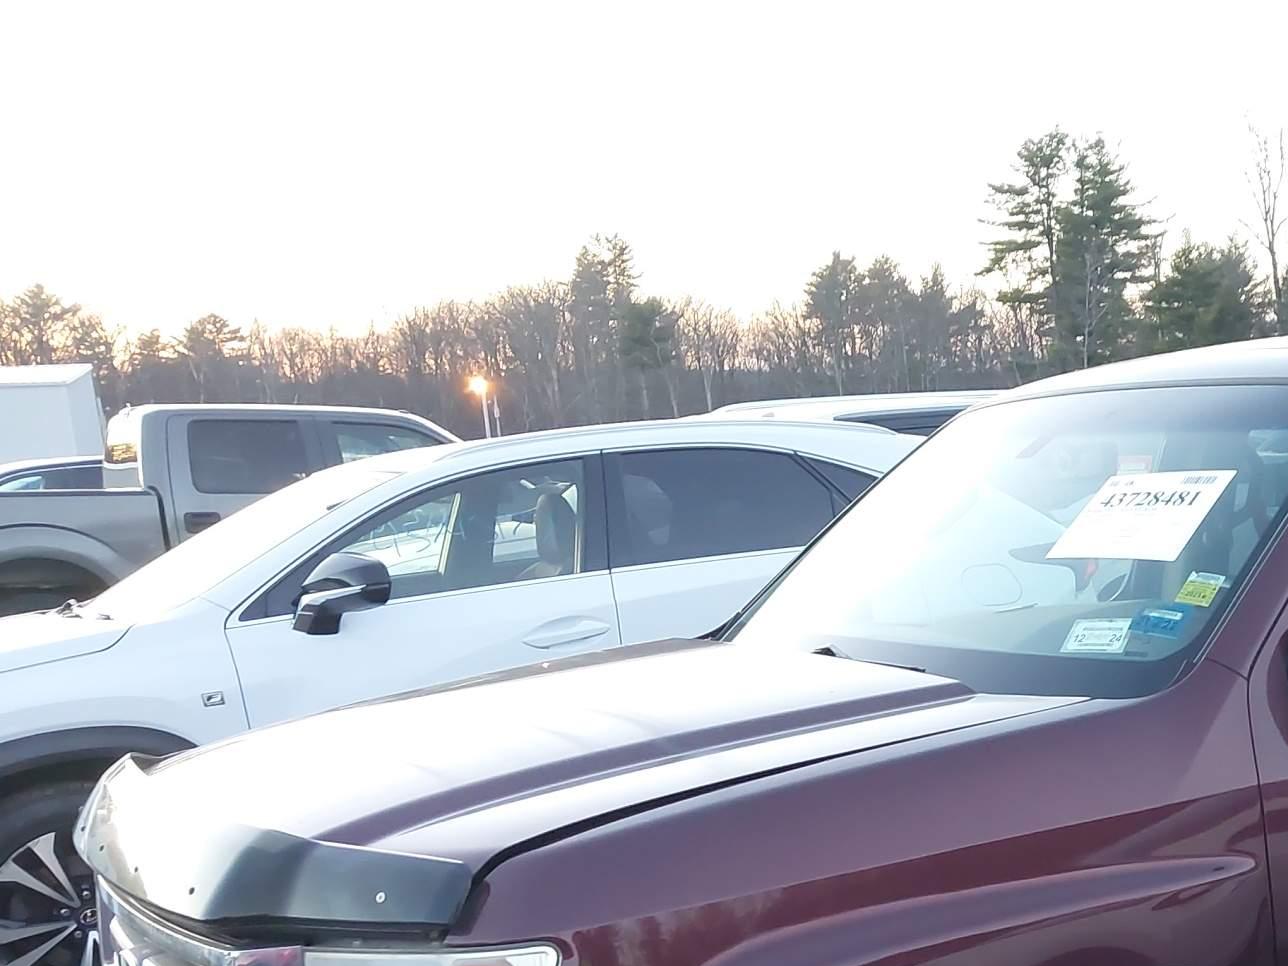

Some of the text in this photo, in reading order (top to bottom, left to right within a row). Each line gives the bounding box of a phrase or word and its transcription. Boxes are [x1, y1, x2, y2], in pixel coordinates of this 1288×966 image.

[1100, 490, 1201, 507] 43728481
[1073, 633, 1123, 643] 12 24
